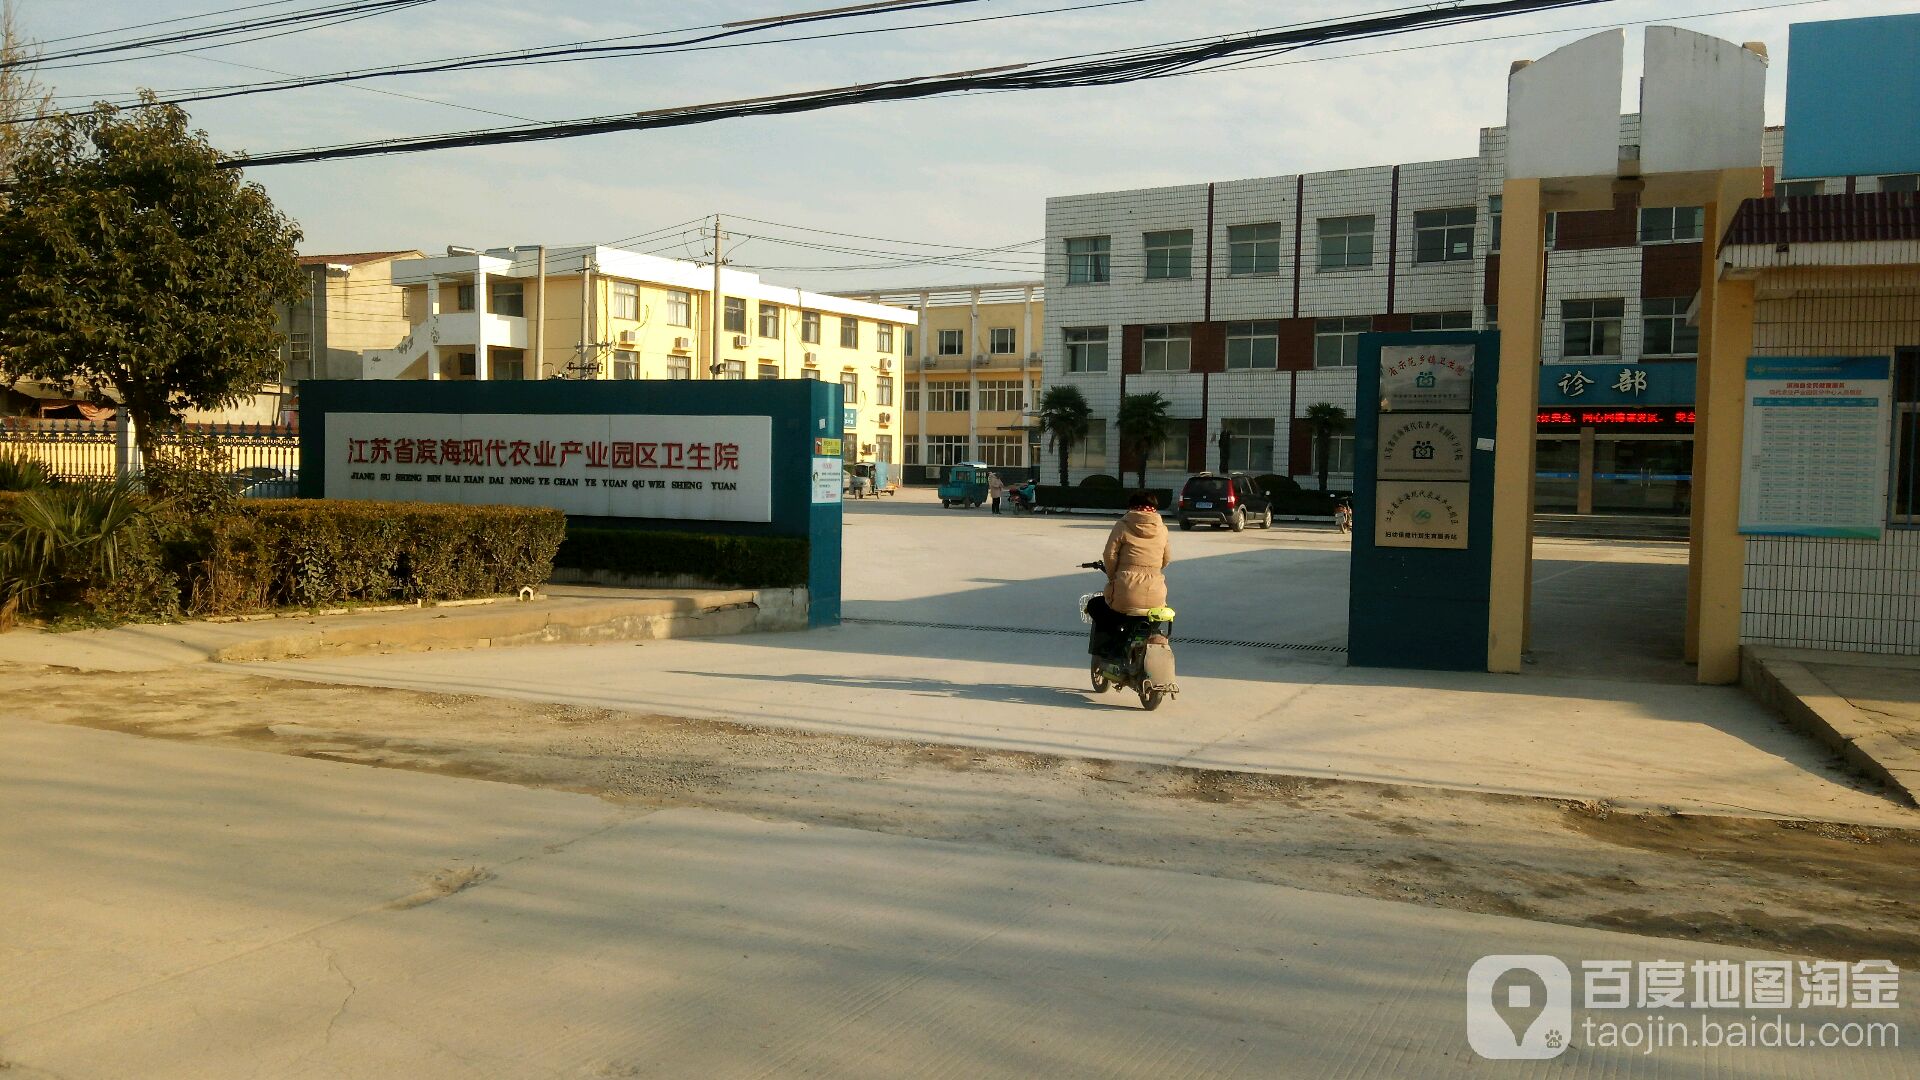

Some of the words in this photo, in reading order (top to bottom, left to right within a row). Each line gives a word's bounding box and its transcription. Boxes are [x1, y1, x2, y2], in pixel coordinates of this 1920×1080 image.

[347, 437, 740, 471] 江苏省滨海现代农业产业园区卫生院
[350, 472, 375, 481] JIANG
[380, 473, 391, 481] SU
[395, 473, 422, 482] SHENG
[445, 475, 461, 483] HAI
[464, 476, 484, 484] XIAN
[489, 476, 504, 484] DAI
[510, 477, 535, 485] NONG
[538, 477, 550, 486] YE
[554, 478, 579, 486] CHAN
[585, 478, 597, 487] YE
[602, 479, 628, 488] YUAN
[632, 480, 645, 489] QU
[648, 481, 665, 489] WEI
[671, 481, 703, 490] SHENG
[711, 482, 737, 490] YUAN
